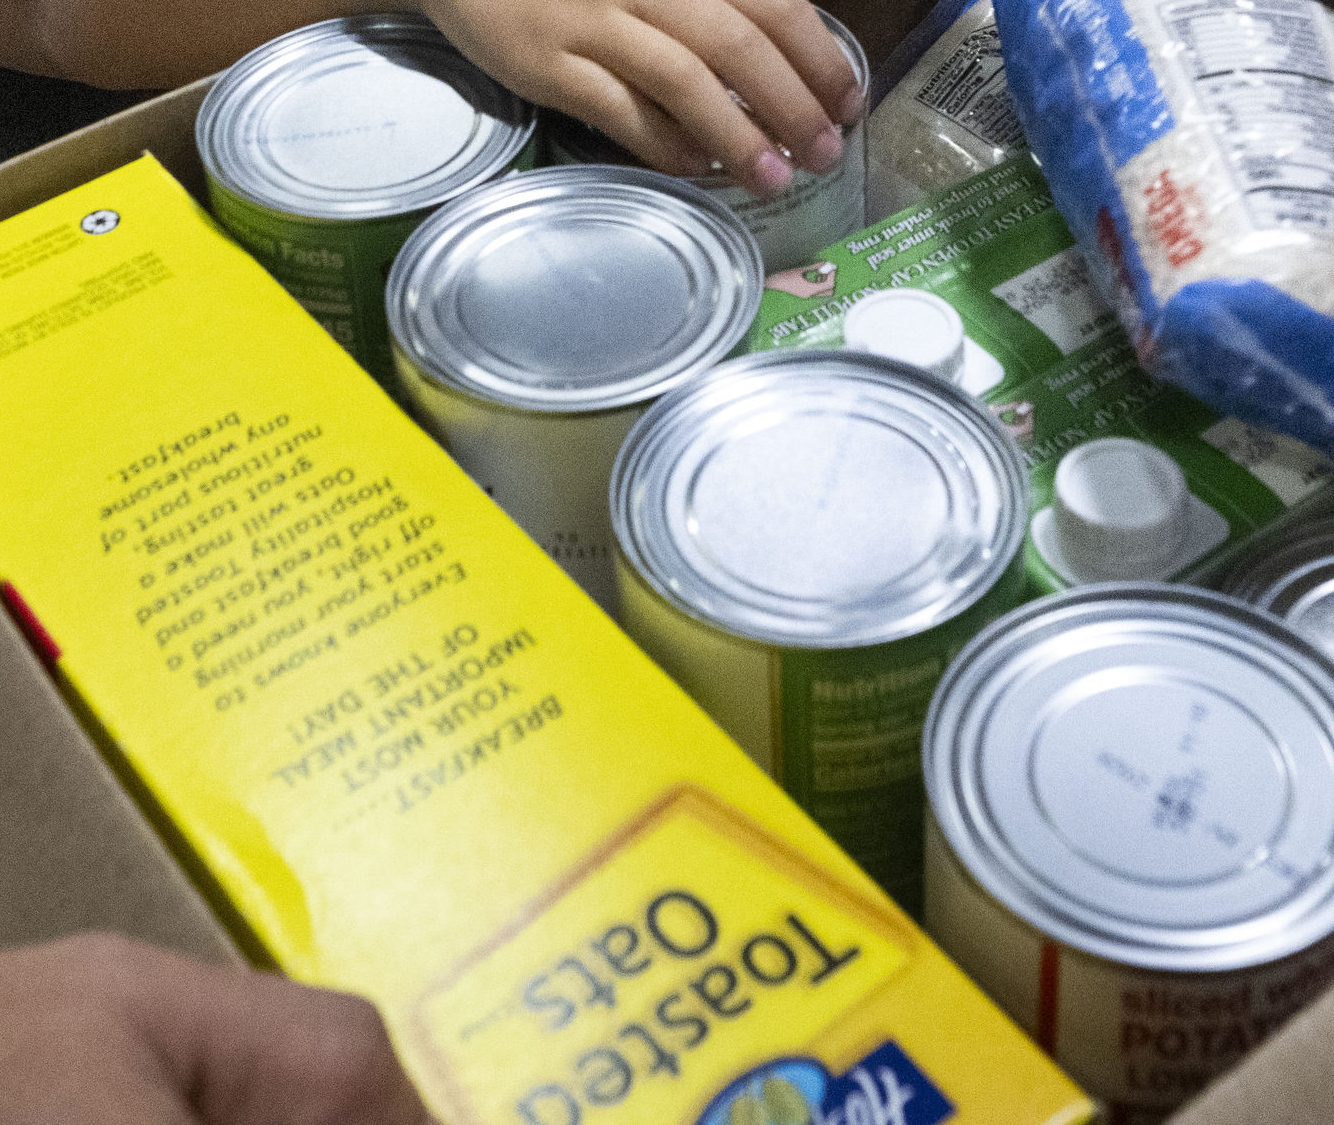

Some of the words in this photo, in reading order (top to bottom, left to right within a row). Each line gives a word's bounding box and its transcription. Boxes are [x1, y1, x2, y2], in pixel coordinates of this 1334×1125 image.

[919, 48, 964, 99] Nutrition
[994, 165, 1020, 183] and
[994, 176, 1032, 202] Twist
[939, 206, 980, 233] break
[978, 198, 995, 210] to
[994, 196, 1037, 231] EASY
[845, 232, 882, 255] ring
[897, 226, 936, 253] inner
[921, 238, 970, 268] OPEN
[970, 225, 994, 247] TO
[866, 248, 896, 271] seal
[890, 262, 921, 288] CAP
[814, 293, 854, 325] PULL
[105, 411, 241, 484] breakfast.
[246, 413, 291, 443] any
[100, 442, 239, 521] wholesome
[199, 424, 323, 495] nutritious
[246, 455, 313, 503] great
[295, 466, 356, 504] Oats
[133, 499, 238, 555] tasting,
[134, 489, 191, 533] part
[242, 501, 288, 537] will
[251, 476, 394, 560] Hospitality
[349, 495, 409, 541] good
[400, 513, 436, 544] off
[100, 527, 128, 556] of
[166, 530, 234, 576] make
[317, 537, 393, 581] right,
[381, 540, 445, 585] start
[136, 558, 243, 627] Toasted
[139, 573, 156, 590] a
[216, 531, 342, 613] breakfast
[264, 578, 312, 615] you
[318, 576, 373, 622] your
[346, 561, 467, 638] Everyone
[155, 609, 206, 649] and
[192, 613, 257, 660] need
[443, 623, 479, 658] OF
[166, 654, 184, 672] a
[194, 617, 307, 689] morning
[254, 634, 339, 690] knows
[366, 652, 434, 698] THE
[215, 687, 246, 712] to
[369, 626, 537, 740] IMPORTANT
[286, 689, 364, 745] DAY!
[432, 678, 521, 736] YOUR
[271, 730, 357, 788] MEAL
[342, 730, 425, 795] MOST
[523, 889, 719, 1032] Oats
[516, 913, 862, 1125] Toasted
[1122, 981, 1251, 1017] sliced
